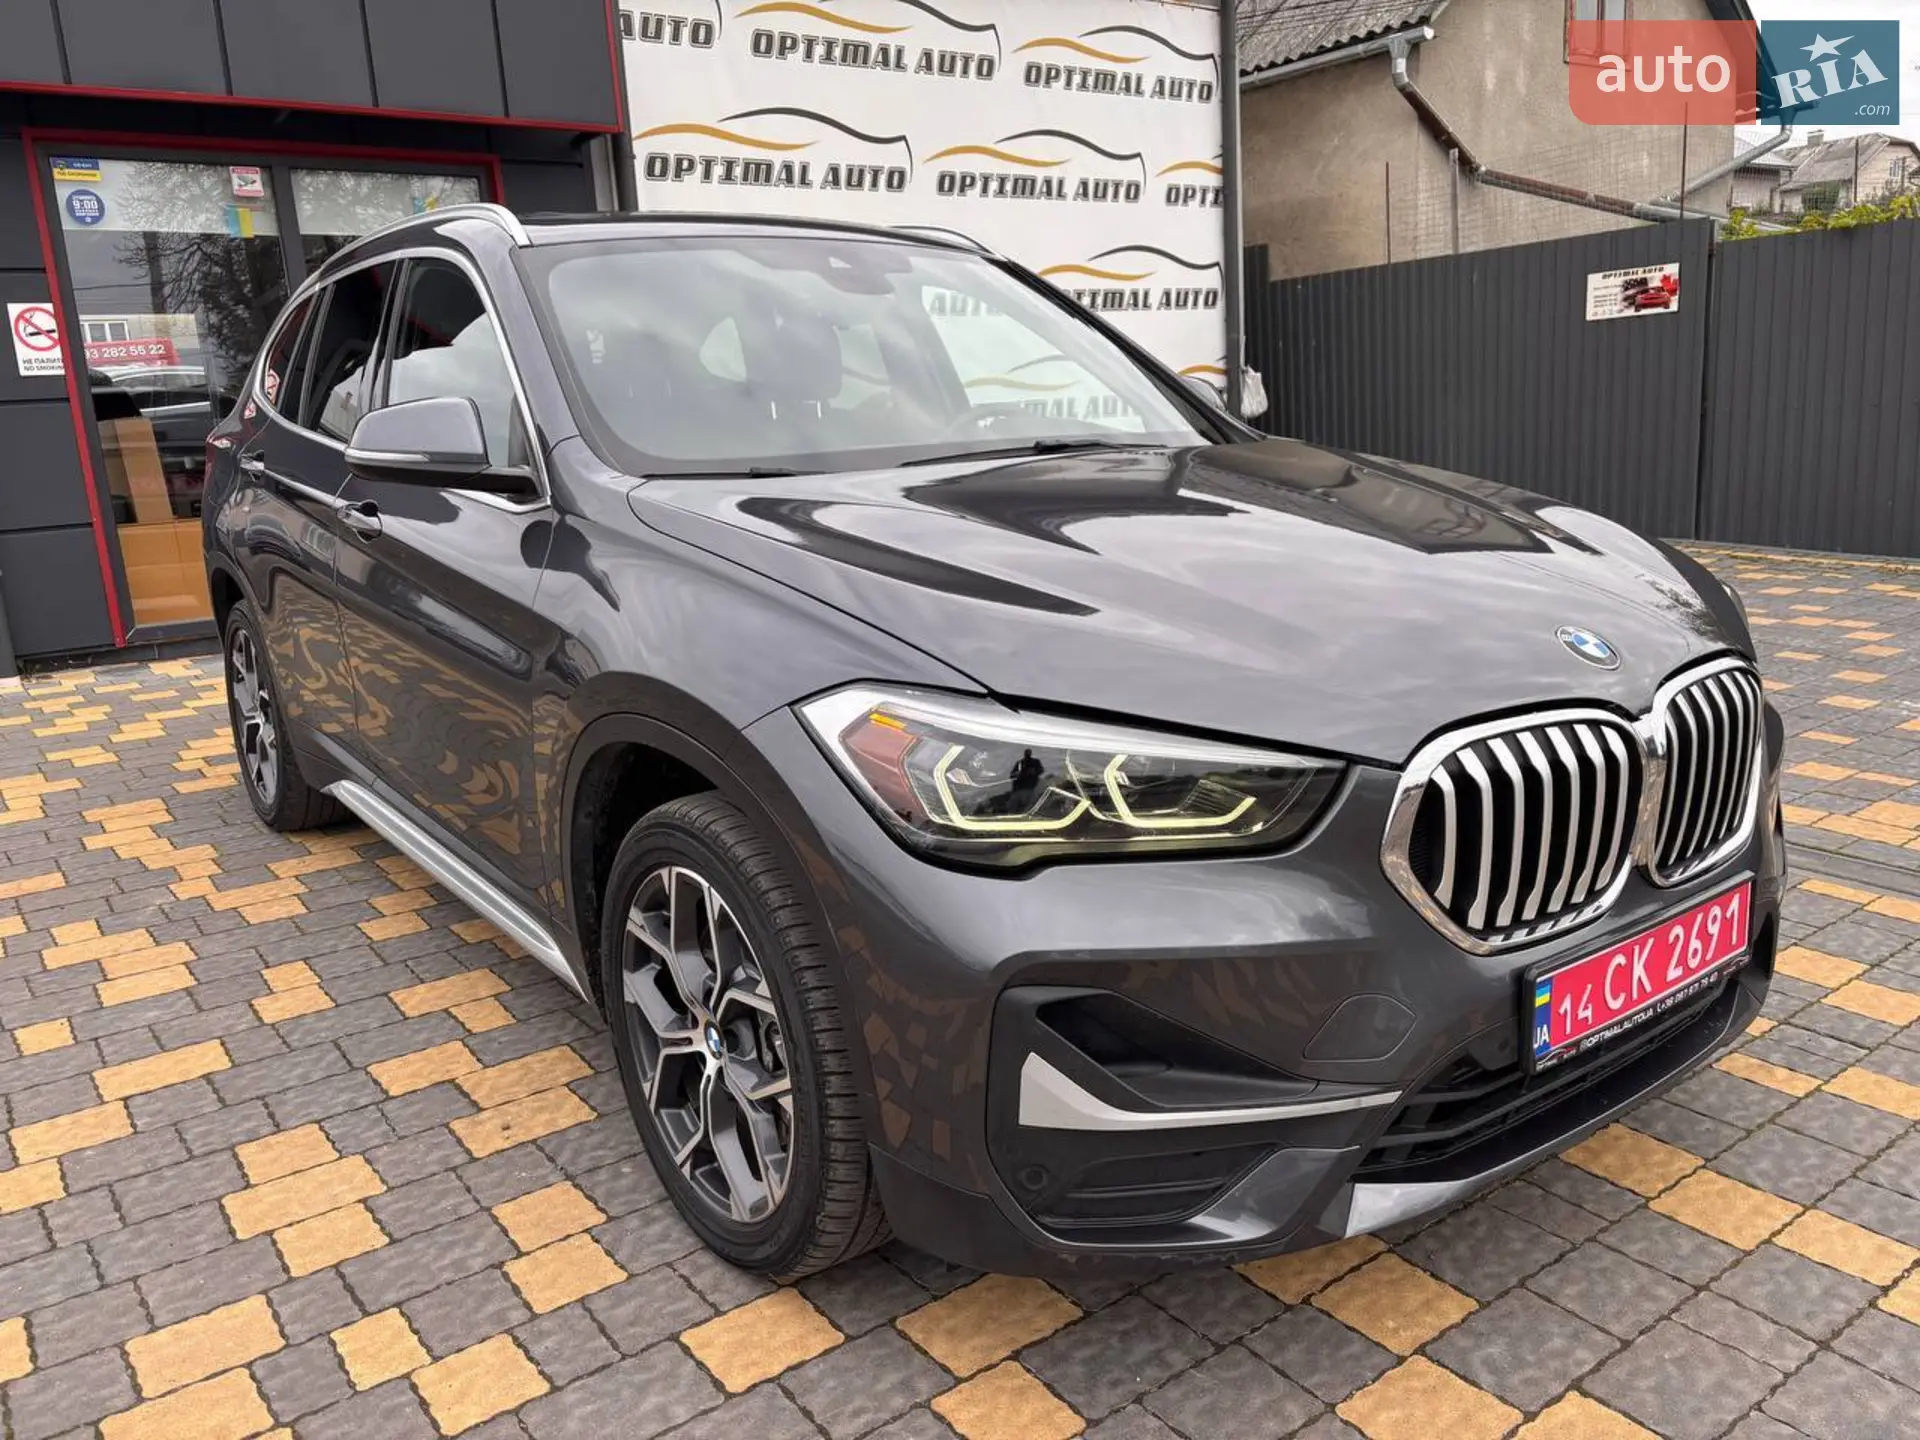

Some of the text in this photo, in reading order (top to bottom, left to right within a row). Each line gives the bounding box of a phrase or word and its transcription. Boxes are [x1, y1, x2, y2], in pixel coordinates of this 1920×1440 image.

[619, 9, 715, 49] AUTO
[750, 28, 997, 80] OPTIMAL AUTO
[1023, 61, 1213, 104] OPTIMAL AUTO
[644, 152, 909, 192] OPTIMAL AUTO
[935, 170, 1141, 203] OPTIMAL AUTO
[1164, 183, 1224, 209] OPTI
[1060, 287, 1219, 312] TIMAL AUTO
[101, 346, 127, 358] 282
[129, 344, 146, 356] 55
[148, 343, 166, 355] 22
[1558, 984, 1593, 1036] 14
[1665, 892, 1741, 982] 2691
